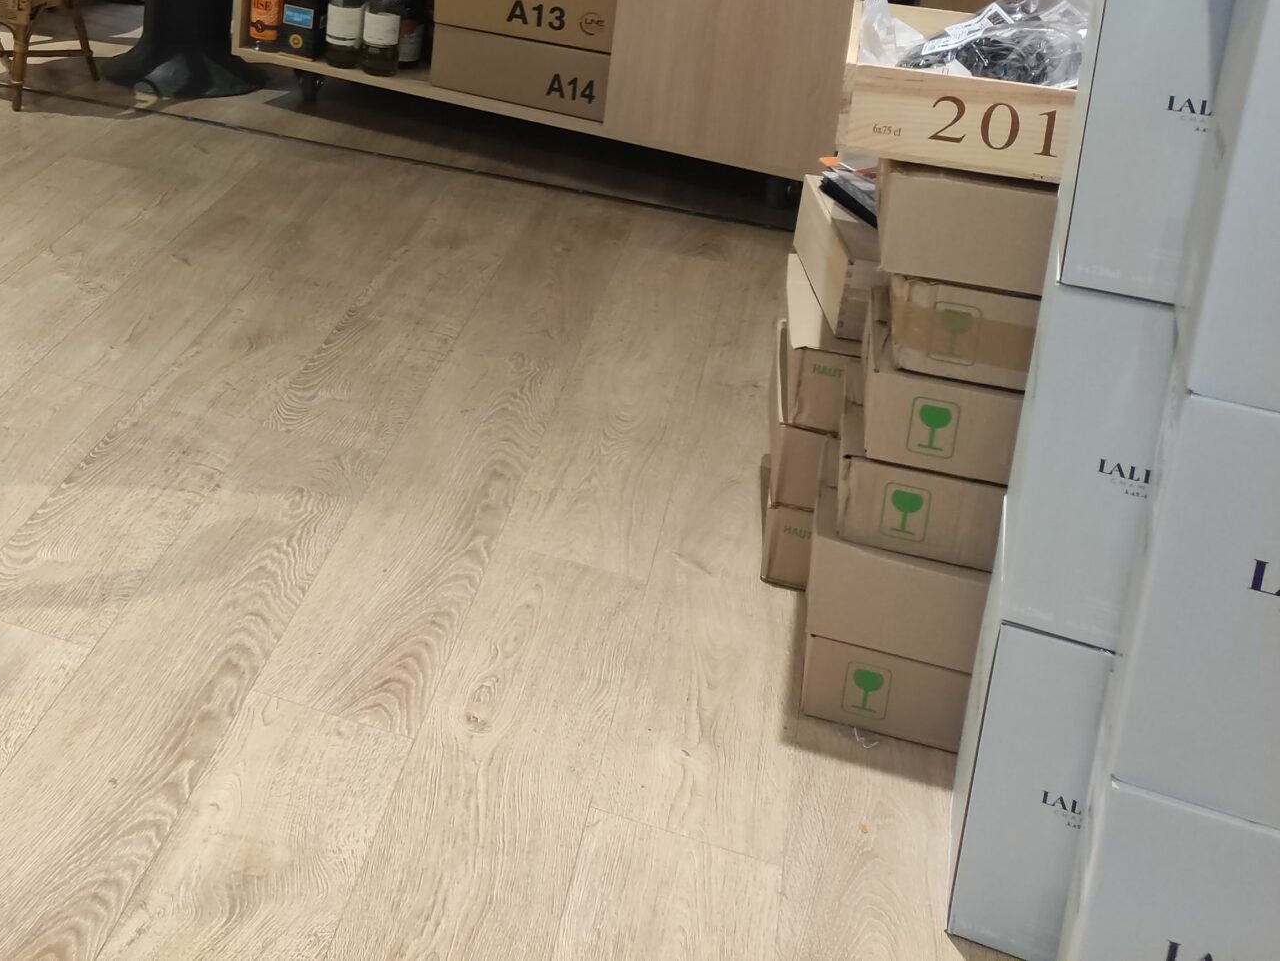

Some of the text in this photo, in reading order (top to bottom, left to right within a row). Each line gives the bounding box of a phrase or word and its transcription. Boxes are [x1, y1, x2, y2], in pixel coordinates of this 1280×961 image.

[506, 0, 566, 31] A13
[546, 73, 595, 104] A14
[872, 123, 892, 136] 6x75
[928, 95, 1058, 158] 201
[813, 364, 844, 378] HAUT
[784, 525, 812, 539] HAUT
